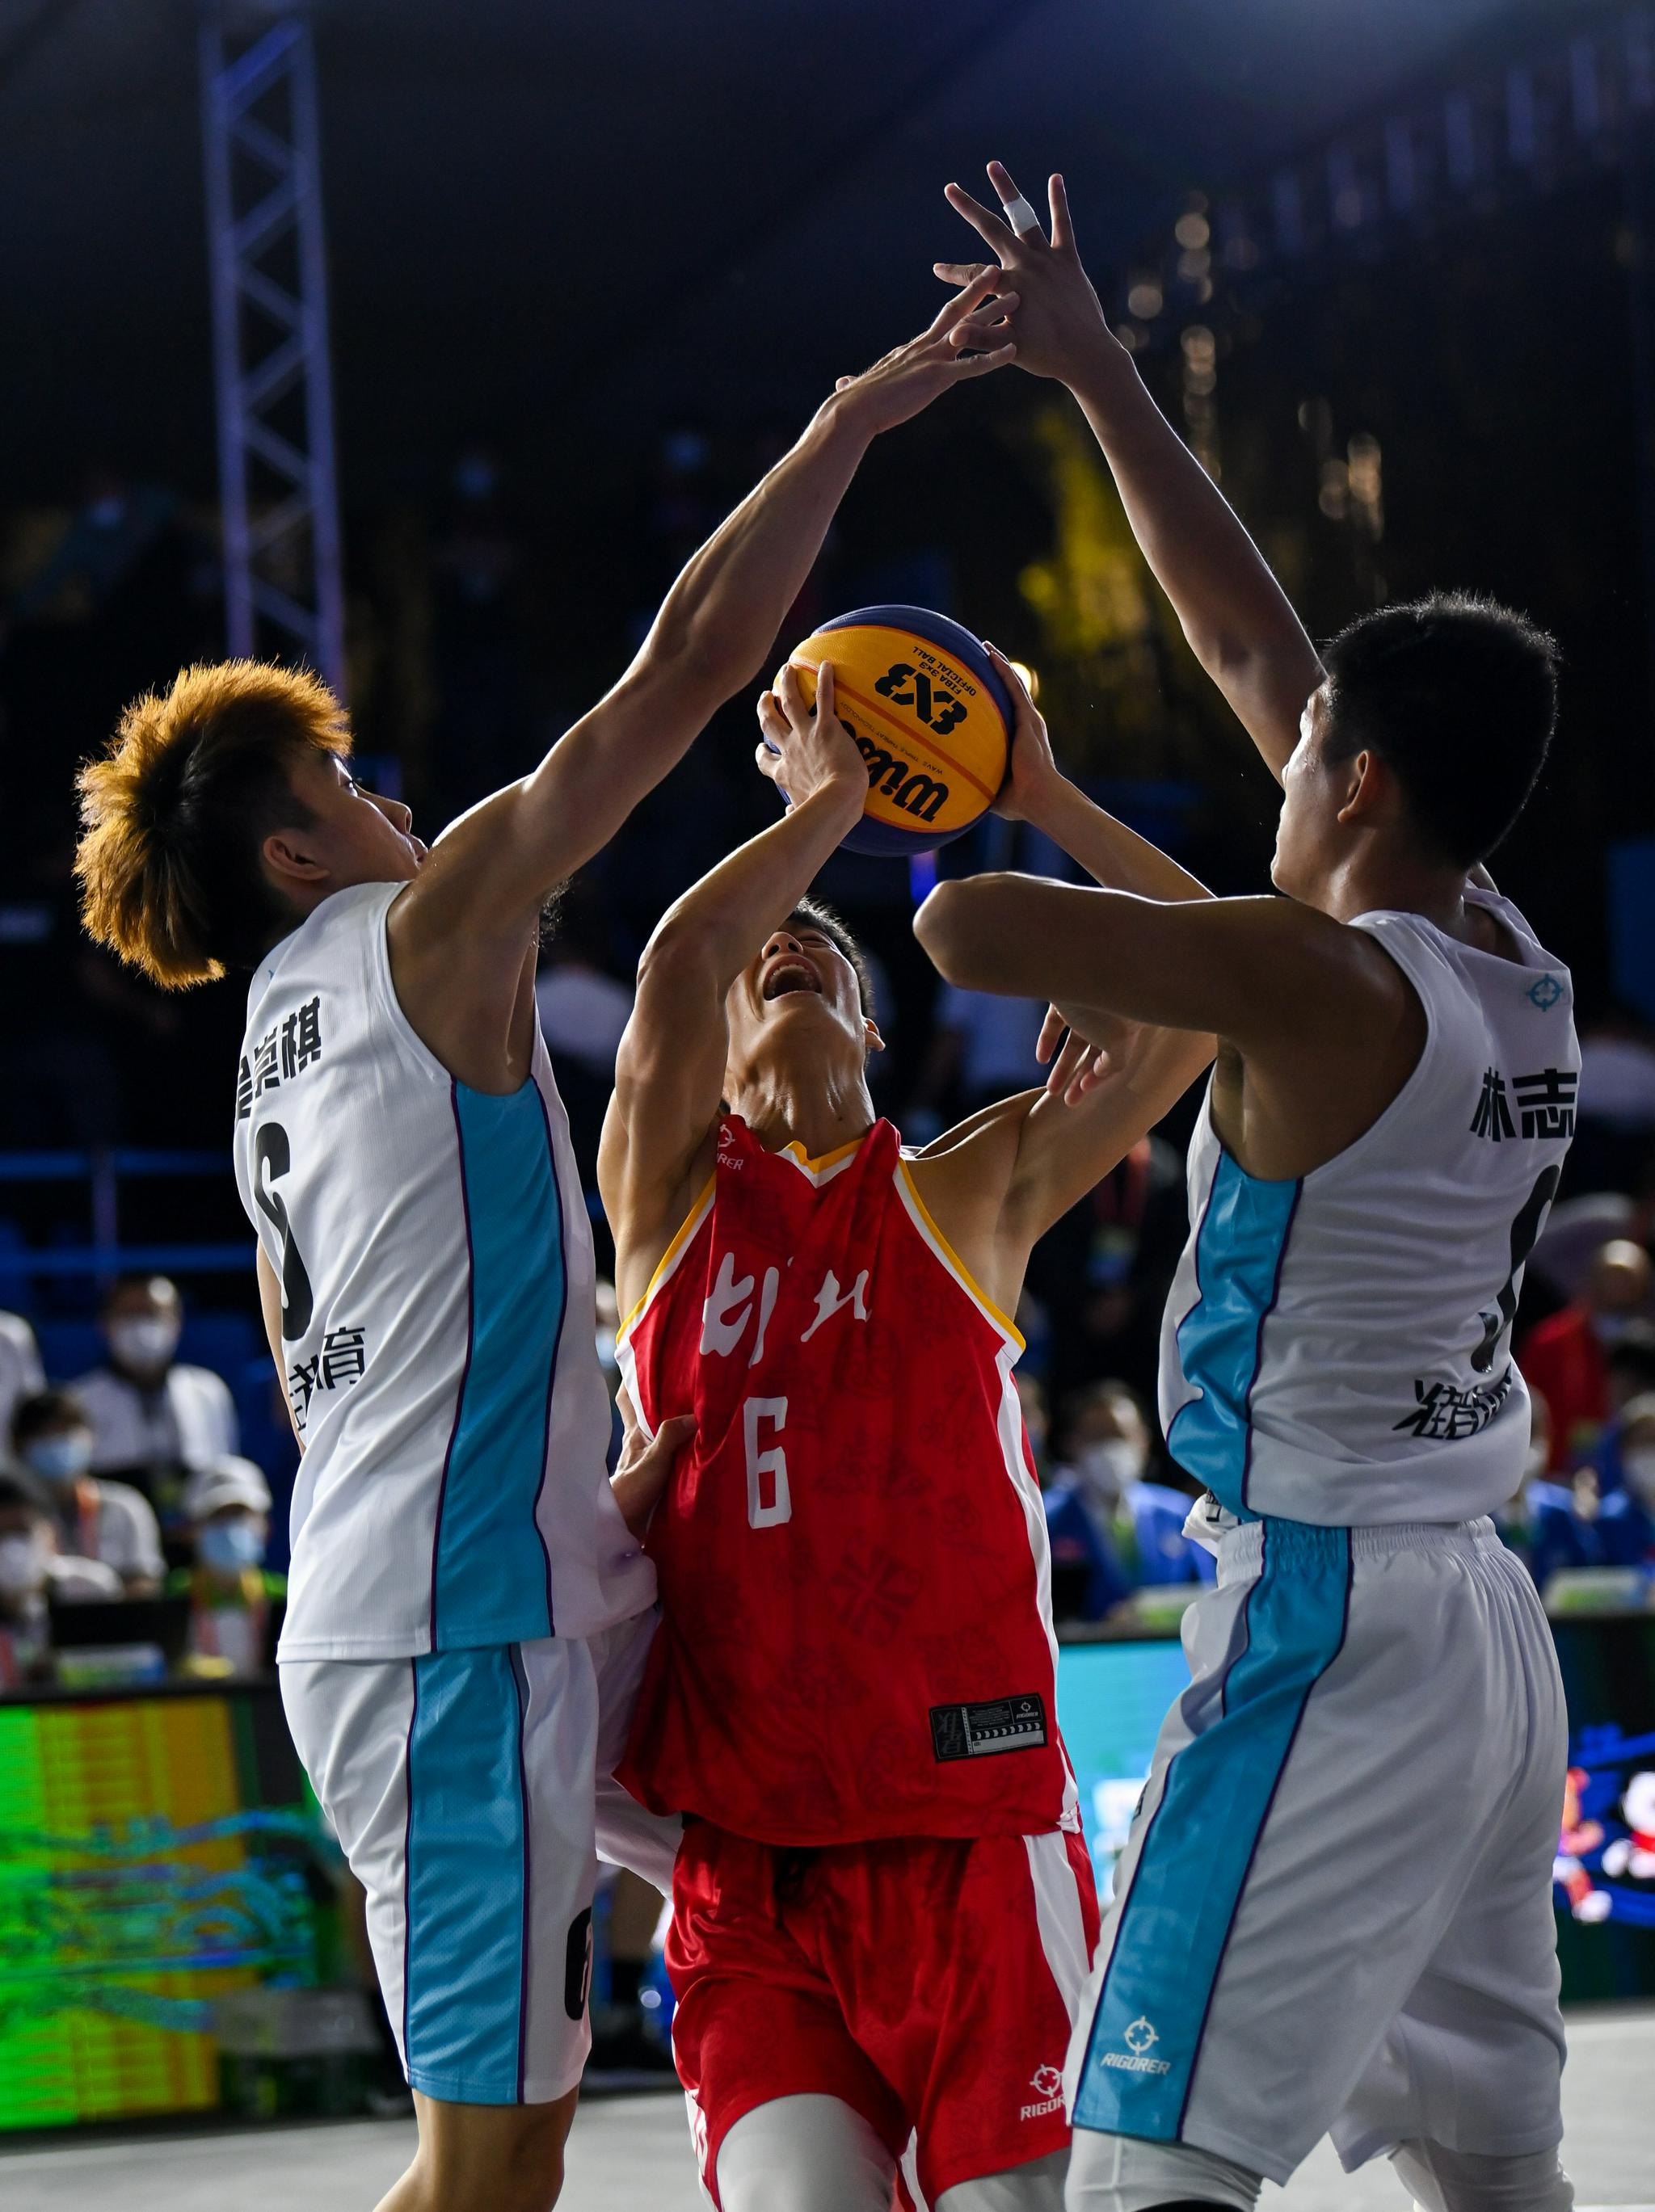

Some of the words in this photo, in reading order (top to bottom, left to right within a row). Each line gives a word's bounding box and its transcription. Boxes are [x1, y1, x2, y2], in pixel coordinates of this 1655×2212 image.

[912, 646, 935, 663] BALL
[935, 661, 976, 696] OFFICIAL
[939, 675, 962, 694] FIBA
[716, 1152, 744, 1171] RER
[743, 1396, 792, 1529] 6
[1100, 2052, 1171, 2075] RIGORER
